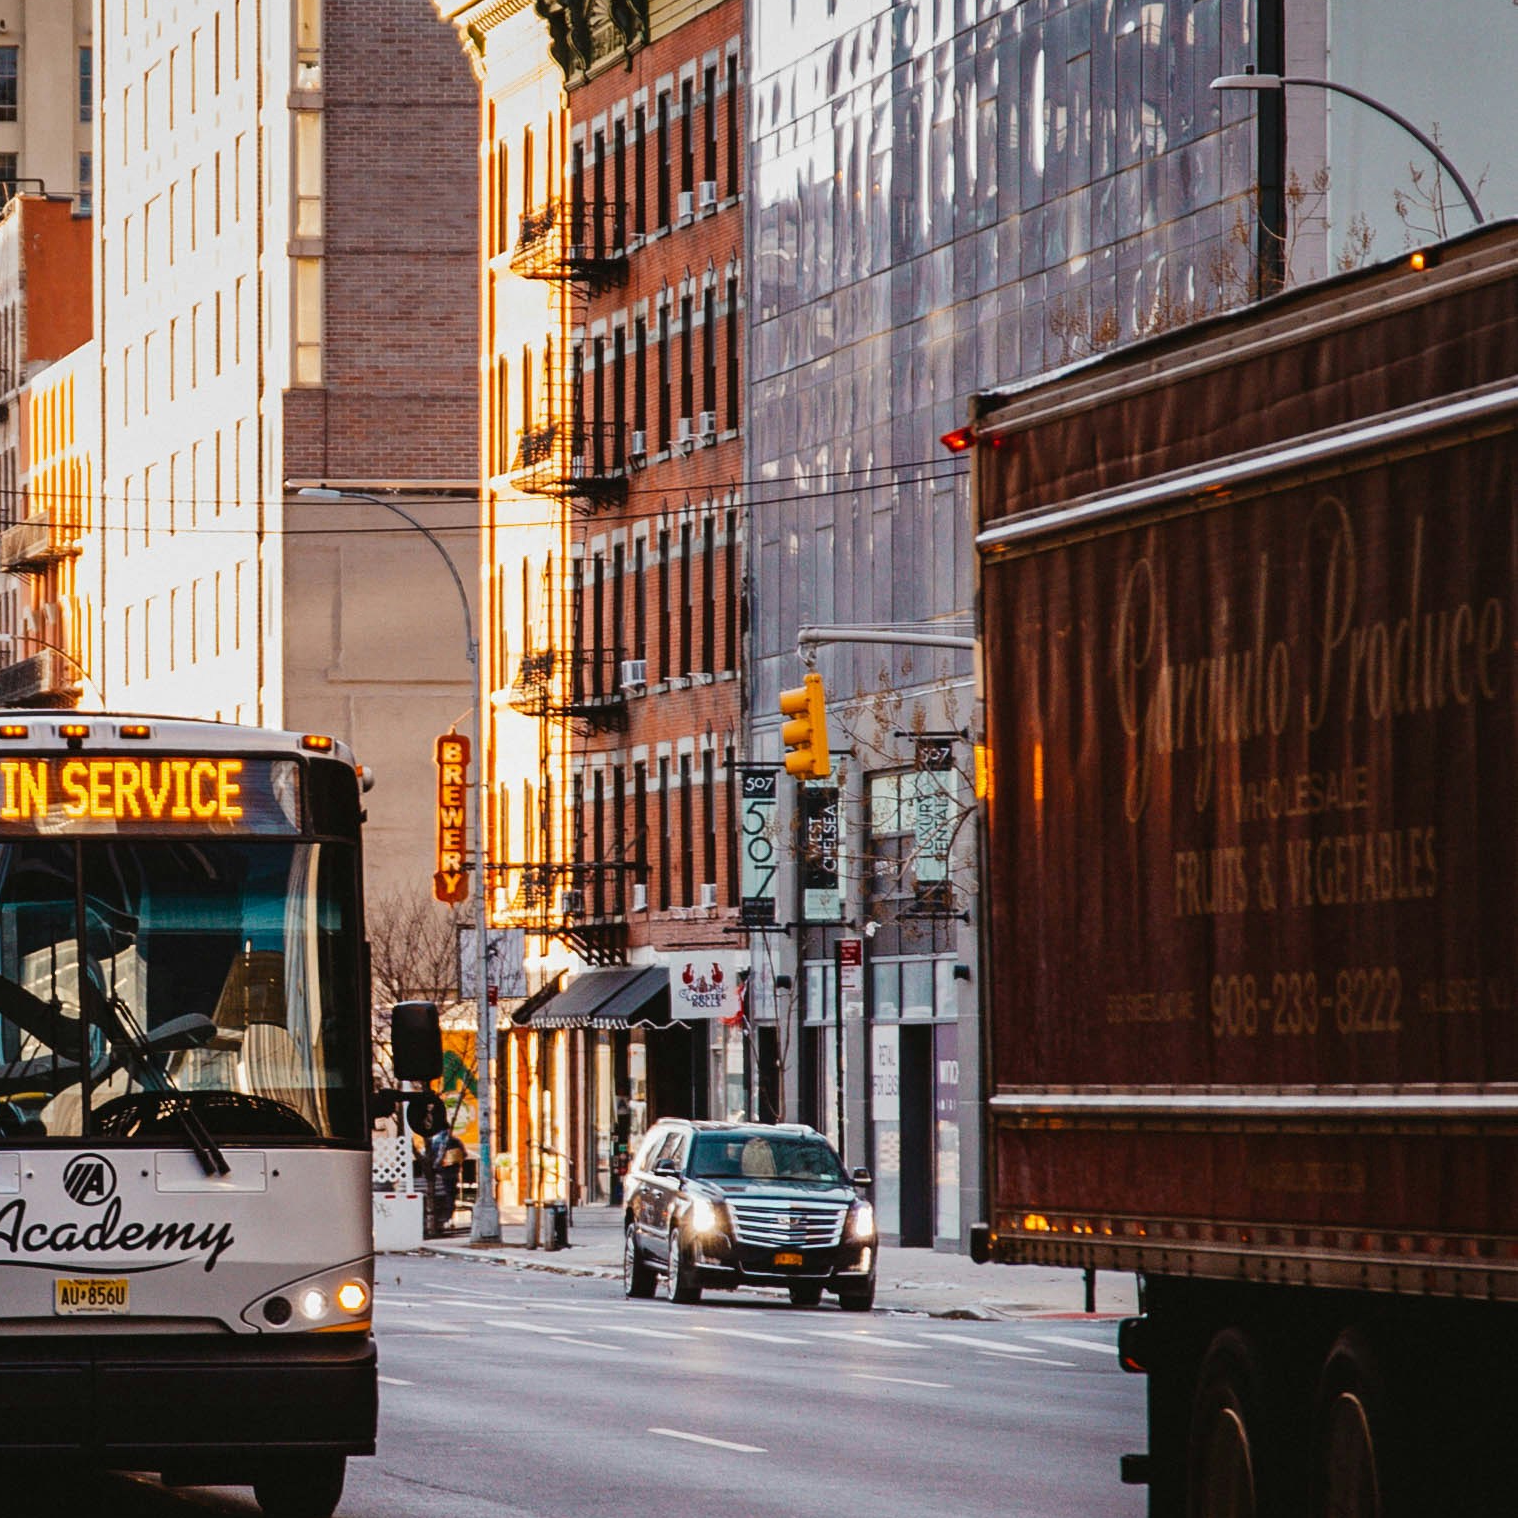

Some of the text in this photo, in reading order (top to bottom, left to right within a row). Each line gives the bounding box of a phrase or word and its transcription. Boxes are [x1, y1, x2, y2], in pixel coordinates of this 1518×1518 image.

[1302, 495, 1503, 732] Produce
[0, 760, 48, 818] IN
[62, 760, 244, 818] SERVICE
[745, 777, 774, 792] 507
[1239, 764, 1370, 824] WHOLESALE
[440, 741, 464, 894] BREWERY
[742, 801, 777, 898] 507
[808, 816, 823, 859] WEST
[822, 803, 837, 873] CHELSEA
[1174, 825, 1437, 918] FRUITS & VEGETABLES
[686, 993, 727, 1002] LOBSTER
[691, 999, 721, 1008] ROLLS
[1209, 965, 1405, 1038] 908-233-8222
